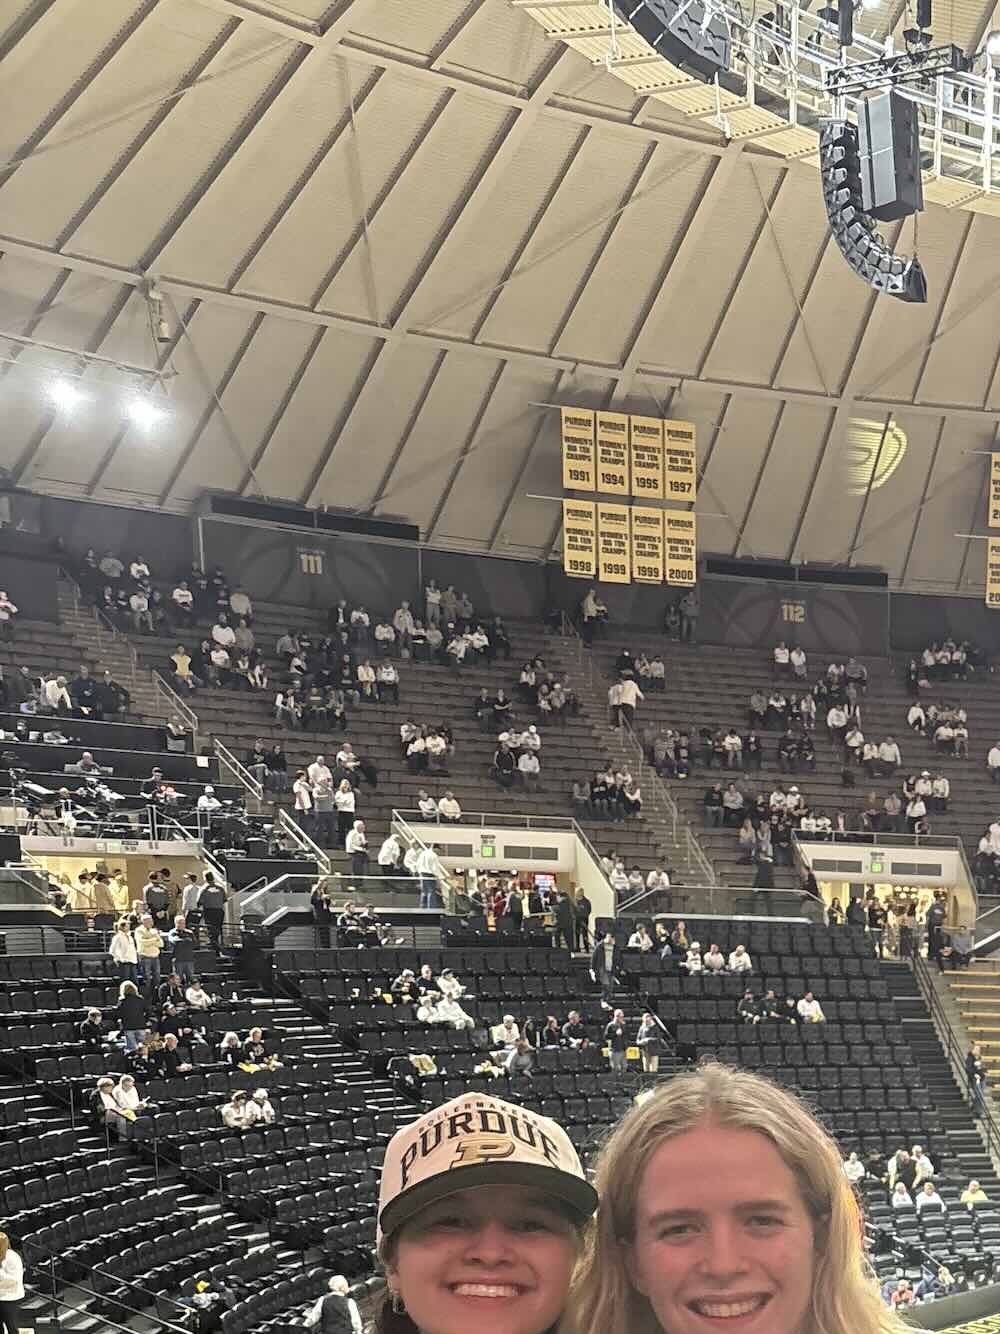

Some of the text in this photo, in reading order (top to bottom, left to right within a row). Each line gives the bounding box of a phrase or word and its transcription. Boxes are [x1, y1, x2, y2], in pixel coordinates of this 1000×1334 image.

[569, 470, 590, 481] 1991
[602, 473, 624, 485] 1994
[636, 477, 658, 489] 1995
[670, 481, 691, 492] 1997
[569, 560, 591, 571] 1998
[603, 563, 626, 575] 1999
[637, 566, 659, 577] 1999
[669, 569, 693, 580] 2000
[418, 1101, 539, 1133] BOILERMAKERS
[401, 1109, 561, 1190] PURDUE
